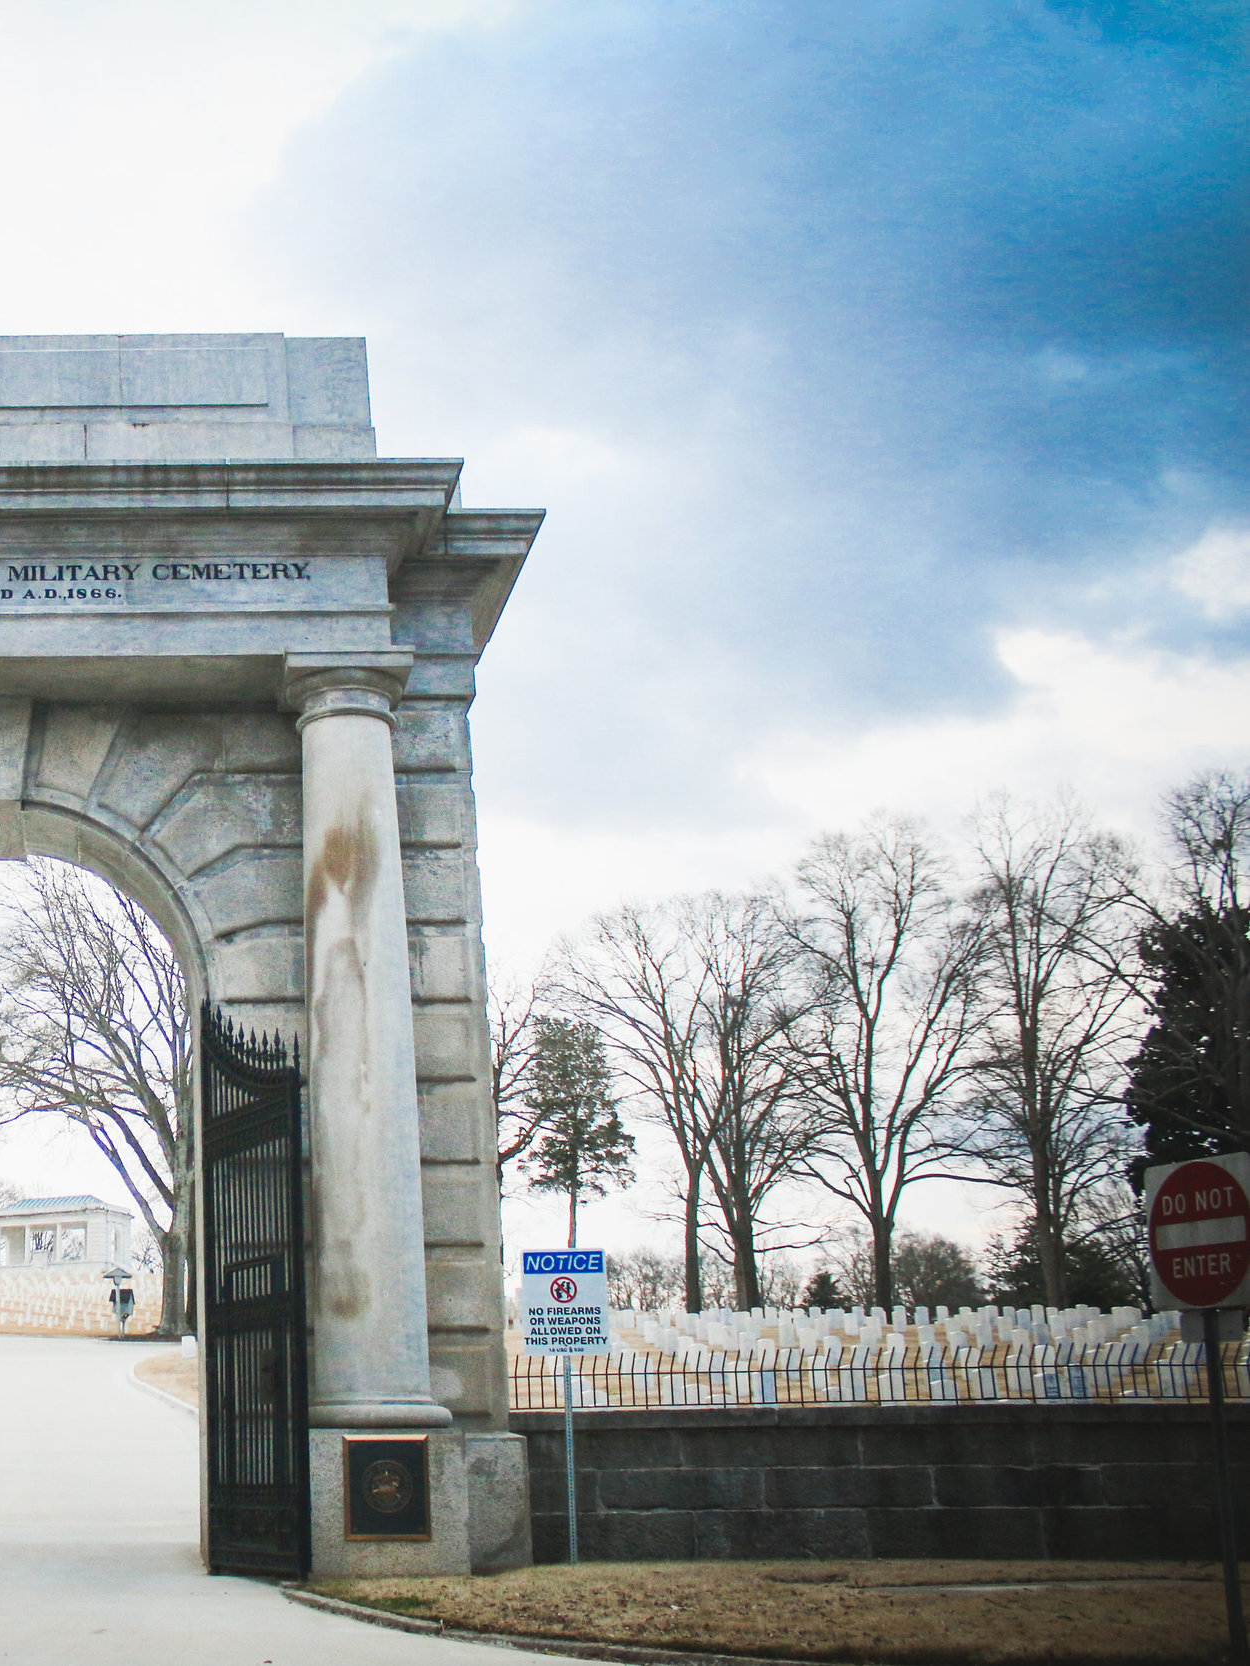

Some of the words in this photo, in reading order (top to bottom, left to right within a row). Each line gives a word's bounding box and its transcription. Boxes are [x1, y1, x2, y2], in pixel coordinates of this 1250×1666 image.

[8, 564, 140, 582] MILITARY
[1161, 1193, 1186, 1216] DO
[1195, 1186, 1234, 1212] NOT
[526, 1254, 601, 1271] NOTICE
[1172, 1253, 1232, 1279] ENTER
[528, 1307, 544, 1316] NO
[547, 1306, 601, 1315] FIREARMS
[529, 1317, 545, 1326] OR
[547, 1316, 601, 1325] WEAPONS
[530, 1327, 582, 1335] ALLOWED
[585, 1326, 601, 1335] ON
[524, 1337, 548, 1345] THIS
[551, 1336, 608, 1345] PROPERTY
